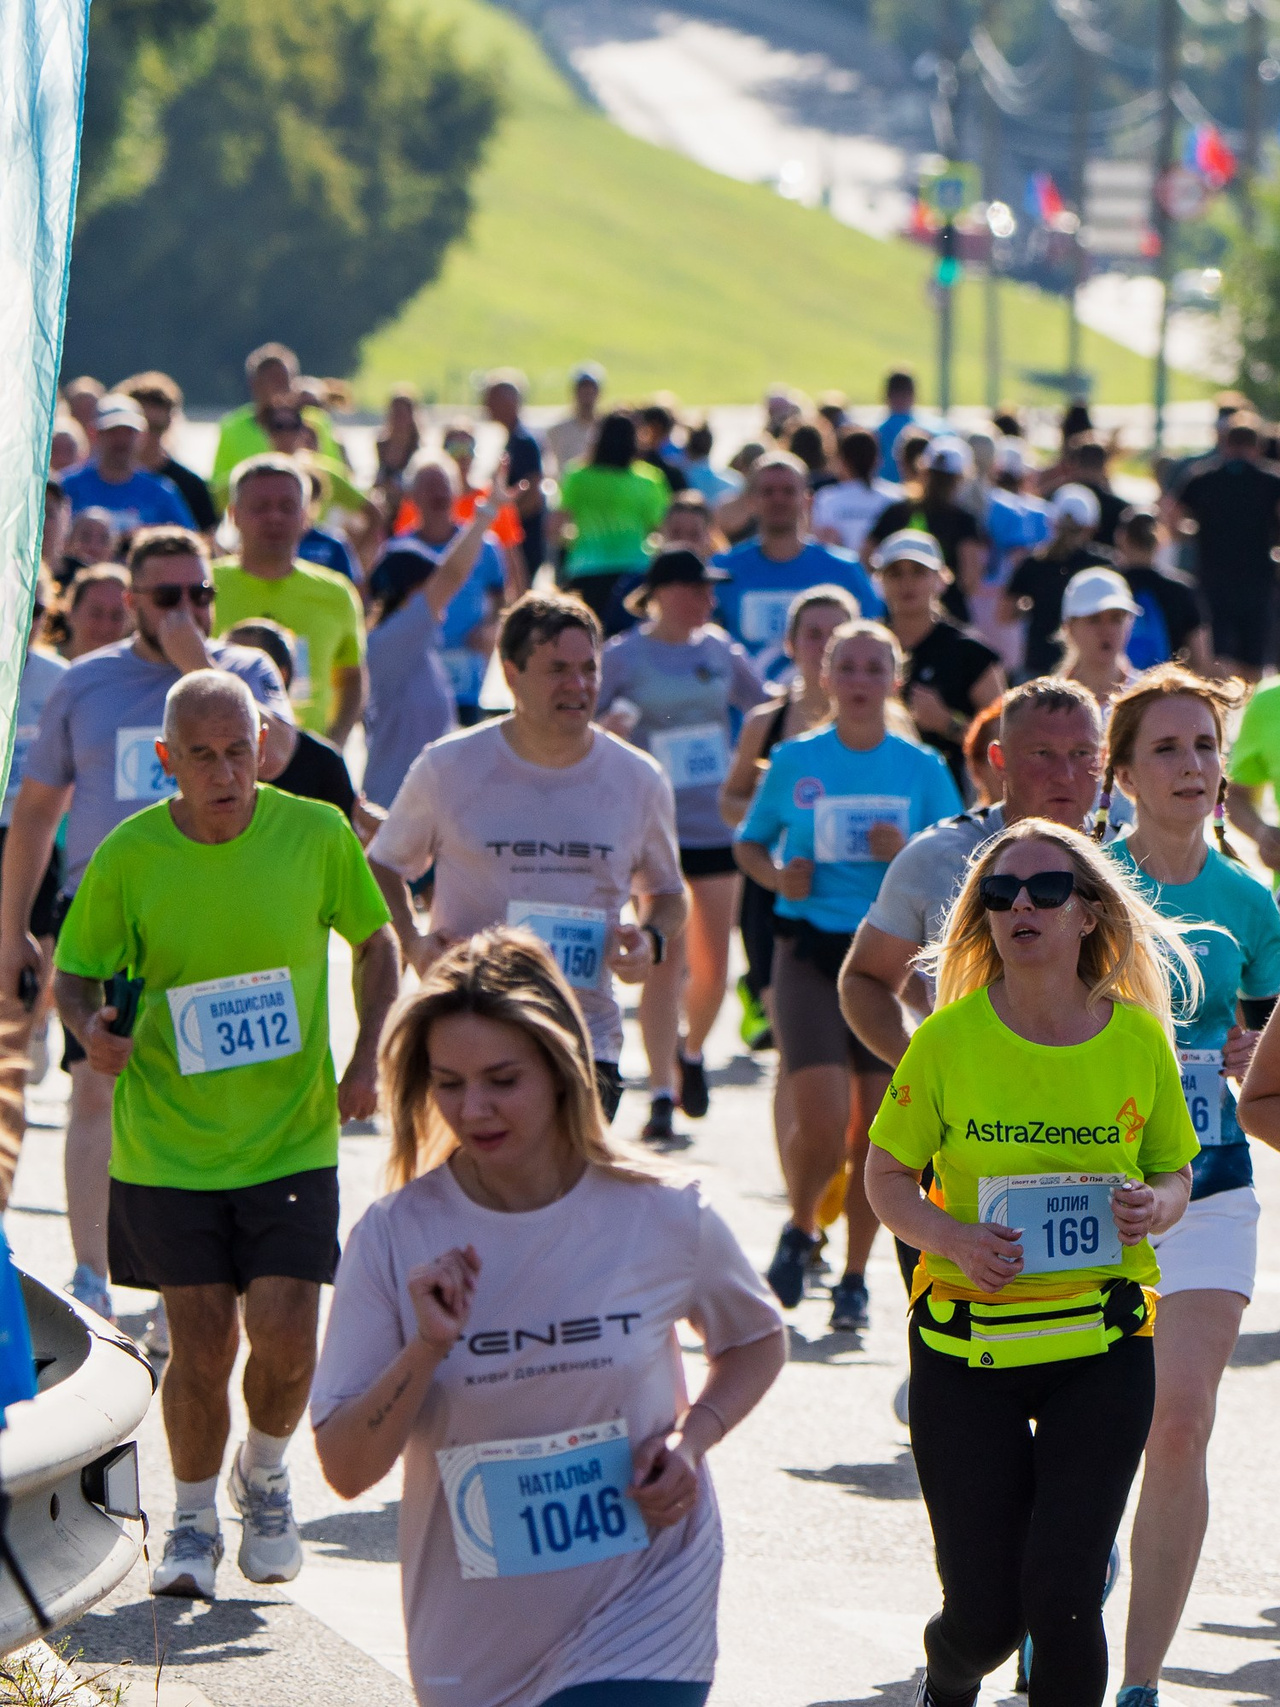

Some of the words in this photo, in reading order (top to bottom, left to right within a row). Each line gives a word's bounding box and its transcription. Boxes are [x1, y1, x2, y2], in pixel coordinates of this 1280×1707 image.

[484, 839, 614, 859] TENET
[209, 991, 285, 1018] ВЛАДИСЛАВ
[217, 1012, 290, 1056] 3412
[1180, 1074, 1197, 1090] НА
[965, 1118, 1120, 1145] AstraZeneca
[1184, 1096, 1209, 1133] 6
[1047, 1195, 1089, 1213] ЮЛИЯ
[1042, 1216, 1099, 1258] 169
[459, 1313, 641, 1355] ENET
[518, 1458, 603, 1496] НАТАЛЬЯ
[519, 1486, 627, 1556] 1046
